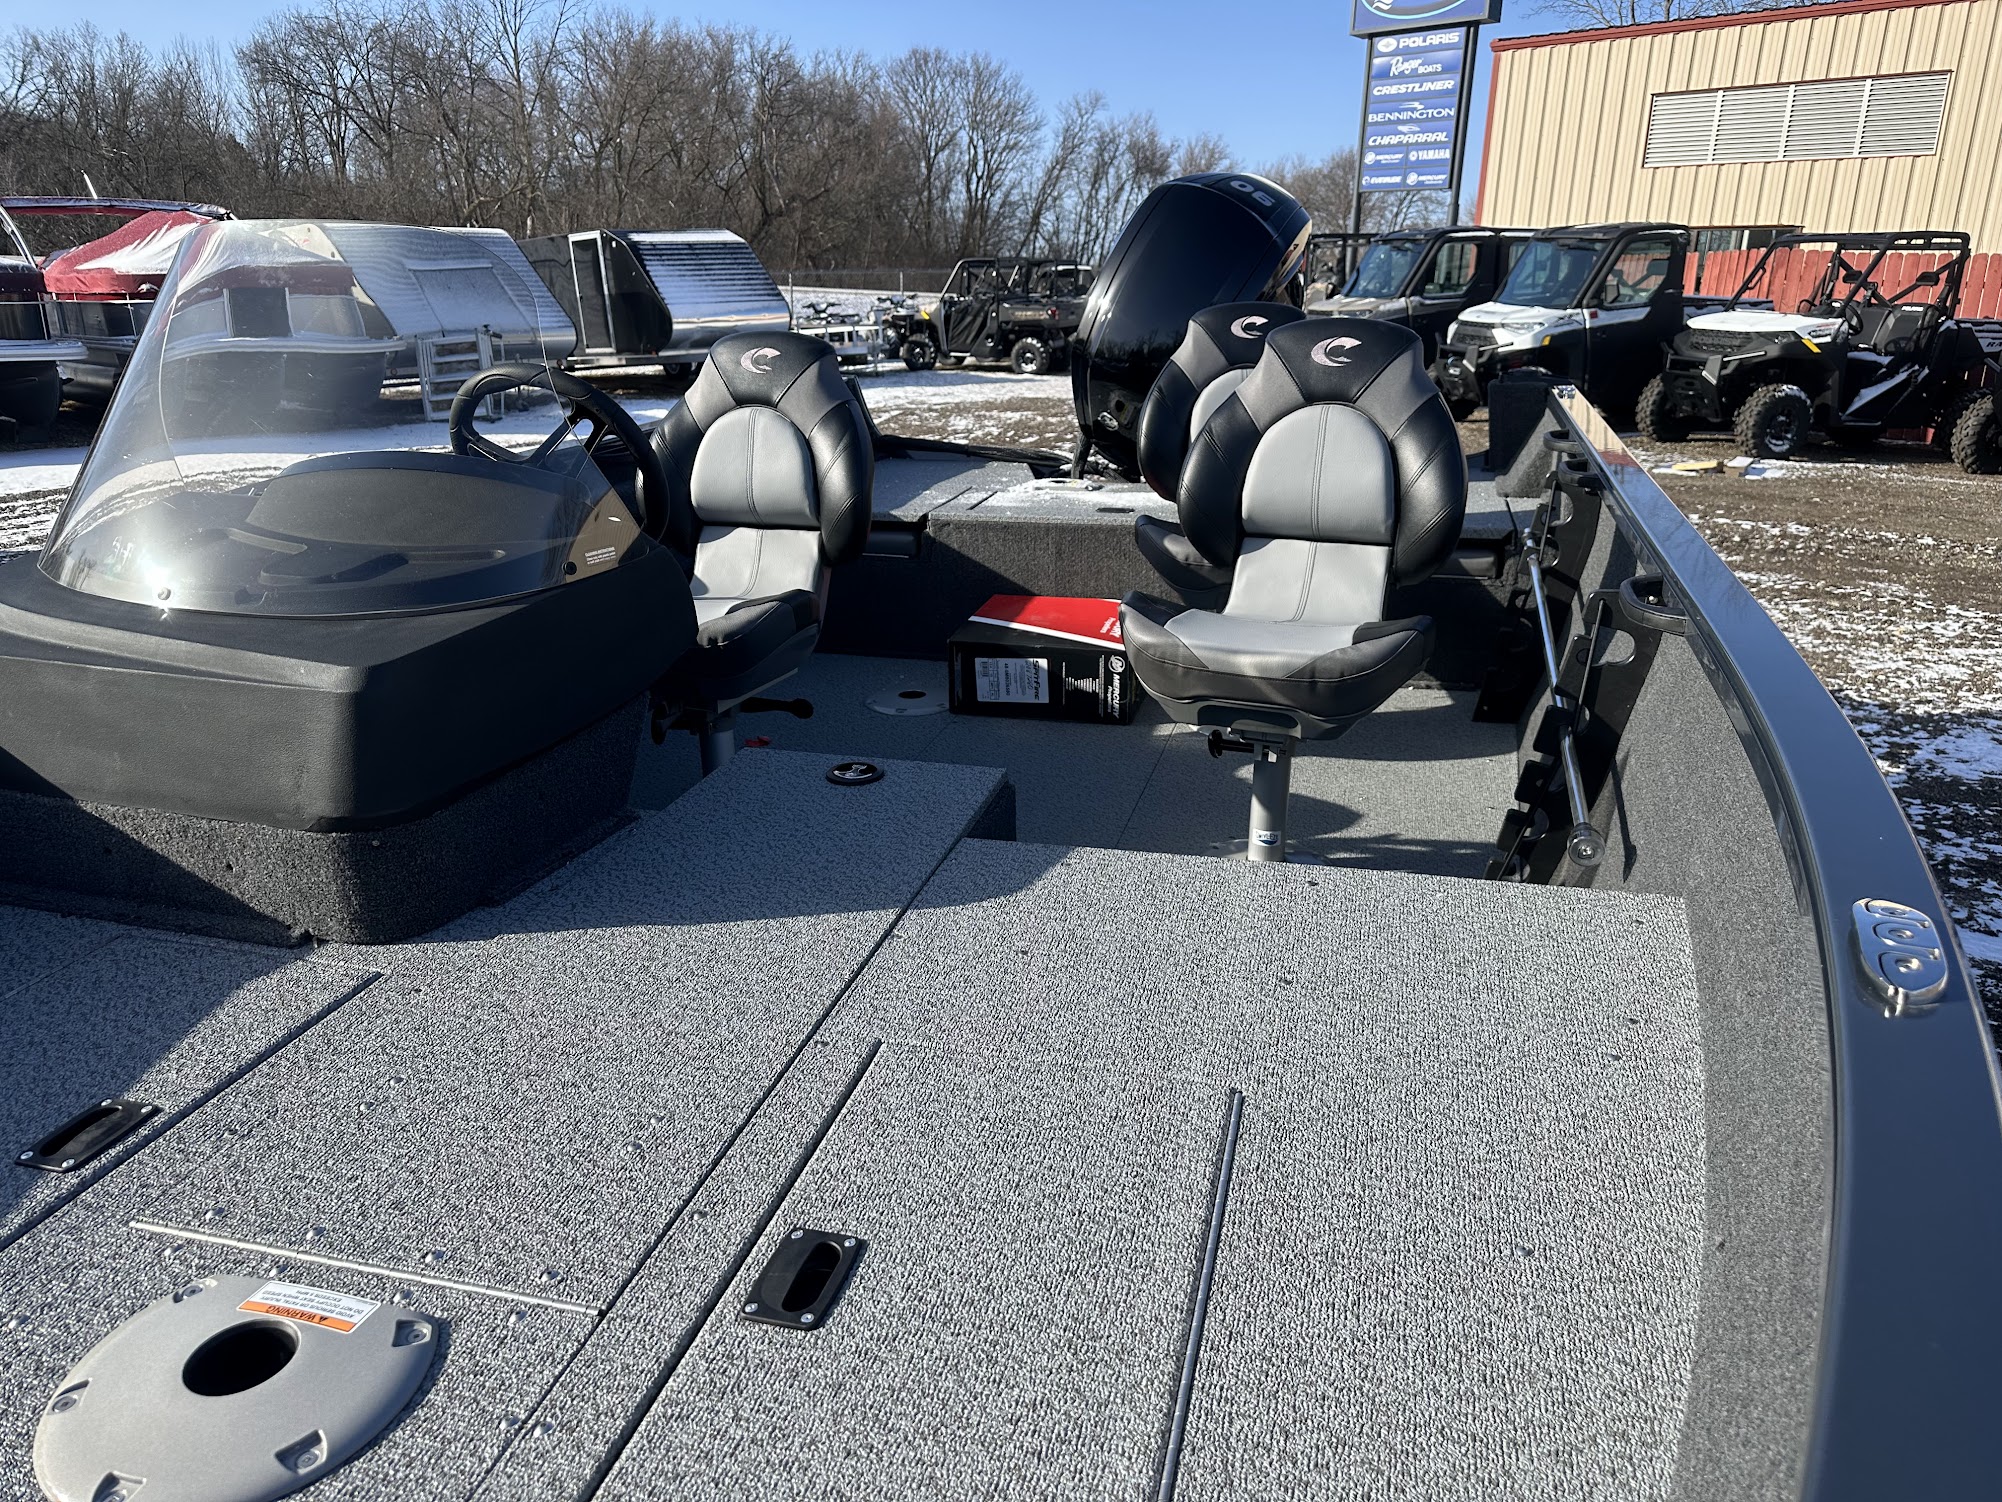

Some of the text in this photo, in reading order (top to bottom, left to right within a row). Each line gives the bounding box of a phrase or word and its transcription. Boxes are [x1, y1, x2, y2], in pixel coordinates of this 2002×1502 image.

[1399, 32, 1460, 48] POLARIS
[1418, 63, 1442, 73] BOATS
[1373, 80, 1455, 96] CRESTLINER
[1368, 107, 1455, 122] BENNINGTON
[1368, 132, 1449, 146] CHAPARRAL
[1418, 149, 1450, 160] YAMAHA
[1112, 673, 1120, 718] MERCURY
[316, 1299, 341, 1309] OCCUPY
[266, 1305, 317, 1323] WARNING
